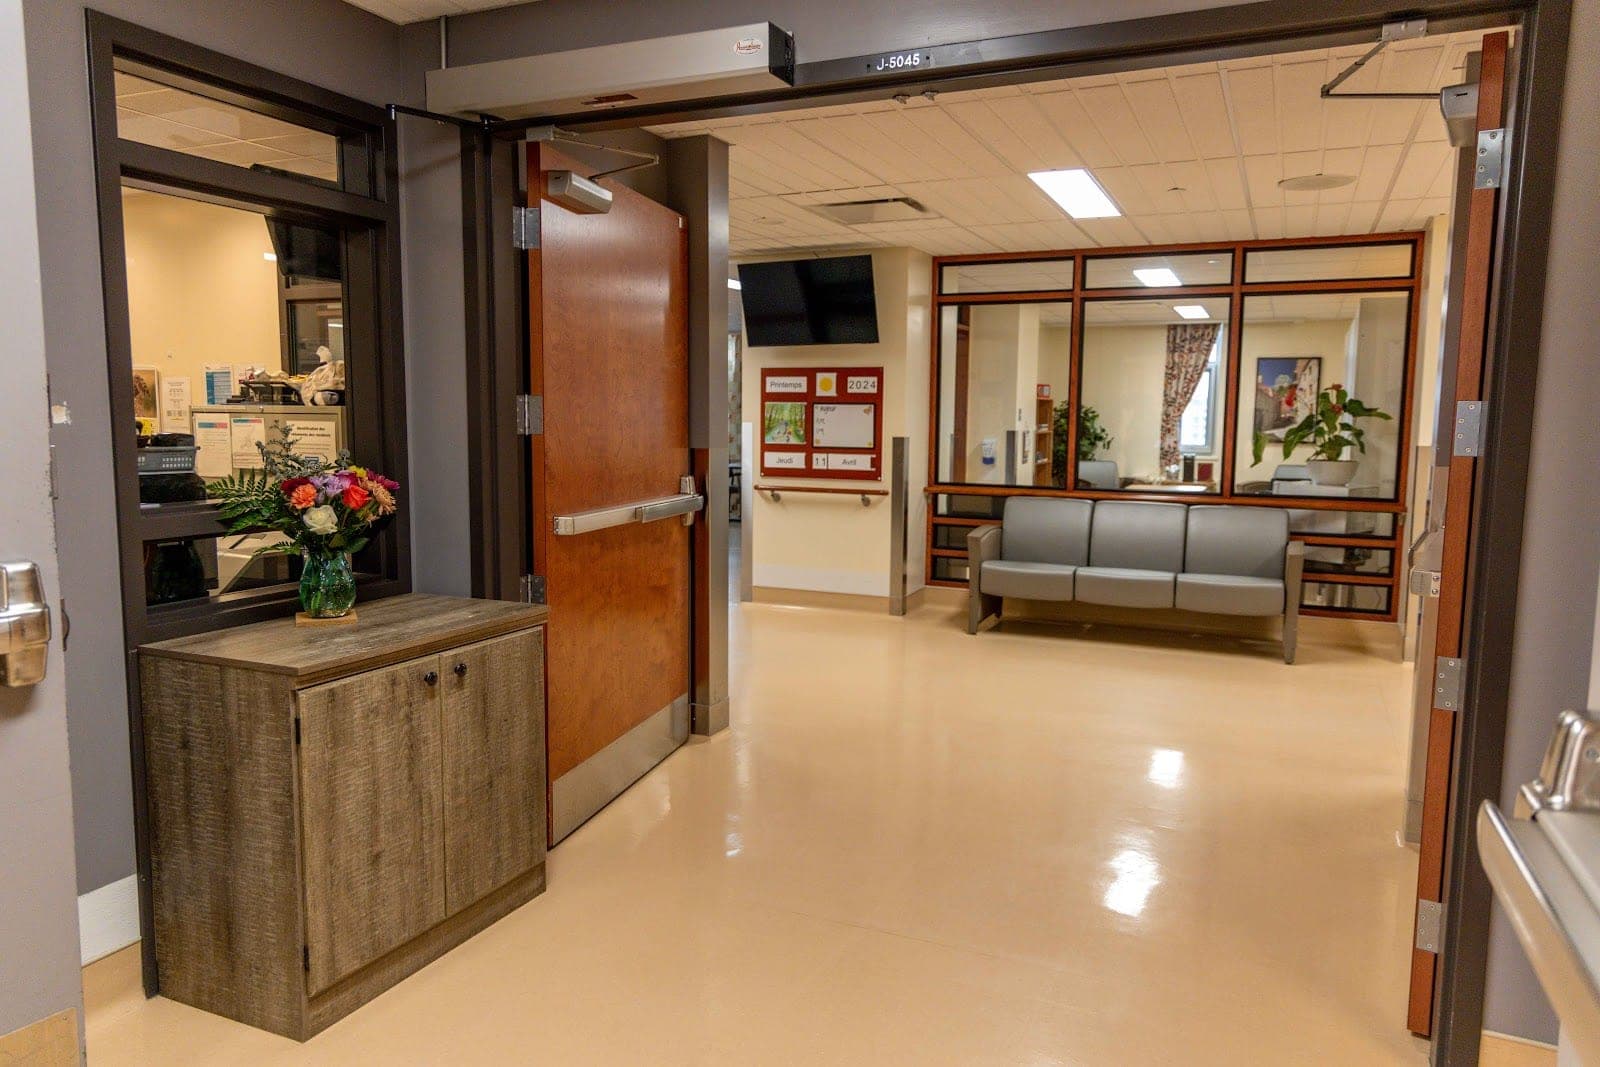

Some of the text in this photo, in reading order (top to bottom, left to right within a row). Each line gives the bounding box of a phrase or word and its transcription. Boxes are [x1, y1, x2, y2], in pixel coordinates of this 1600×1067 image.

[876, 53, 920, 70] J-5045
[770, 380, 876, 389] Printemps 2024
